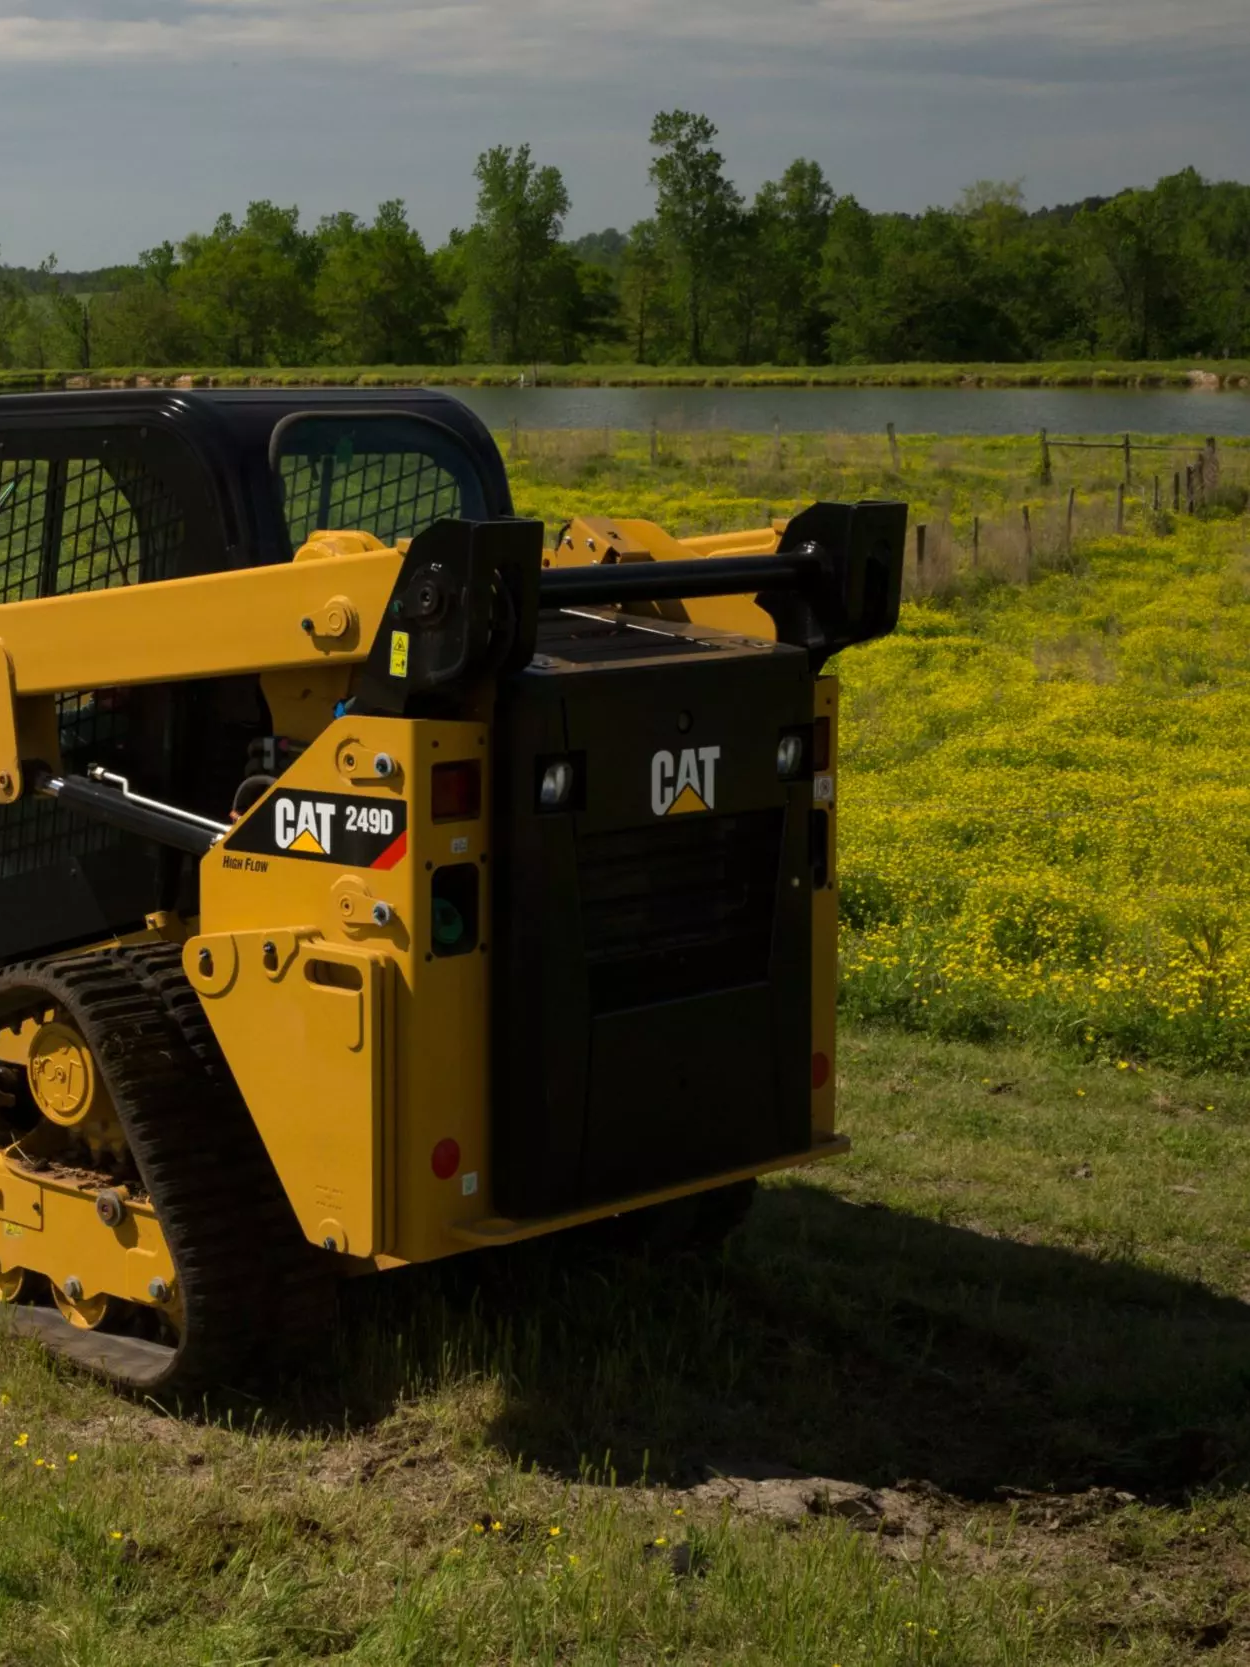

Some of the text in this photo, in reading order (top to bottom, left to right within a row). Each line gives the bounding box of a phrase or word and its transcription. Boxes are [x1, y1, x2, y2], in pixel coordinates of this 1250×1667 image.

[651, 745, 720, 816] CAT
[275, 797, 394, 855] CAT 249D
